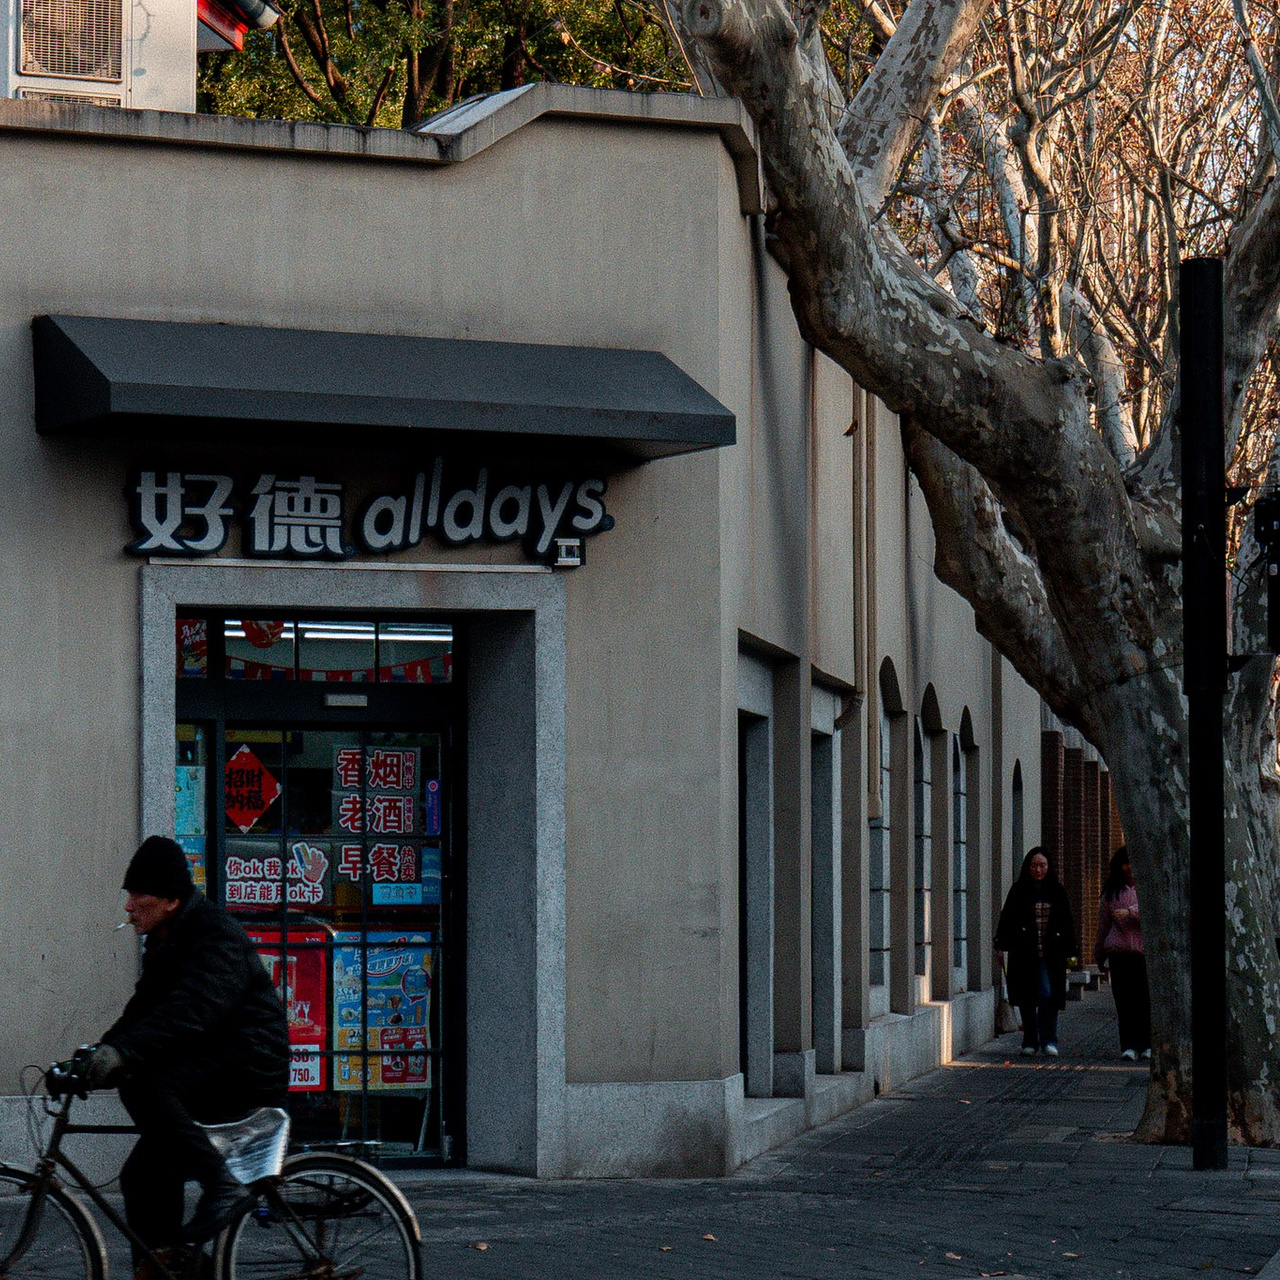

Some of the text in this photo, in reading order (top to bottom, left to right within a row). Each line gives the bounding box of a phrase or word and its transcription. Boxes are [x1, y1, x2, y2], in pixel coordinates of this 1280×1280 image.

[135, 455, 605, 554] 好德 alldays
[337, 749, 404, 789] 香烟
[339, 794, 404, 834] 老酒
[338, 844, 401, 882] 早餐
